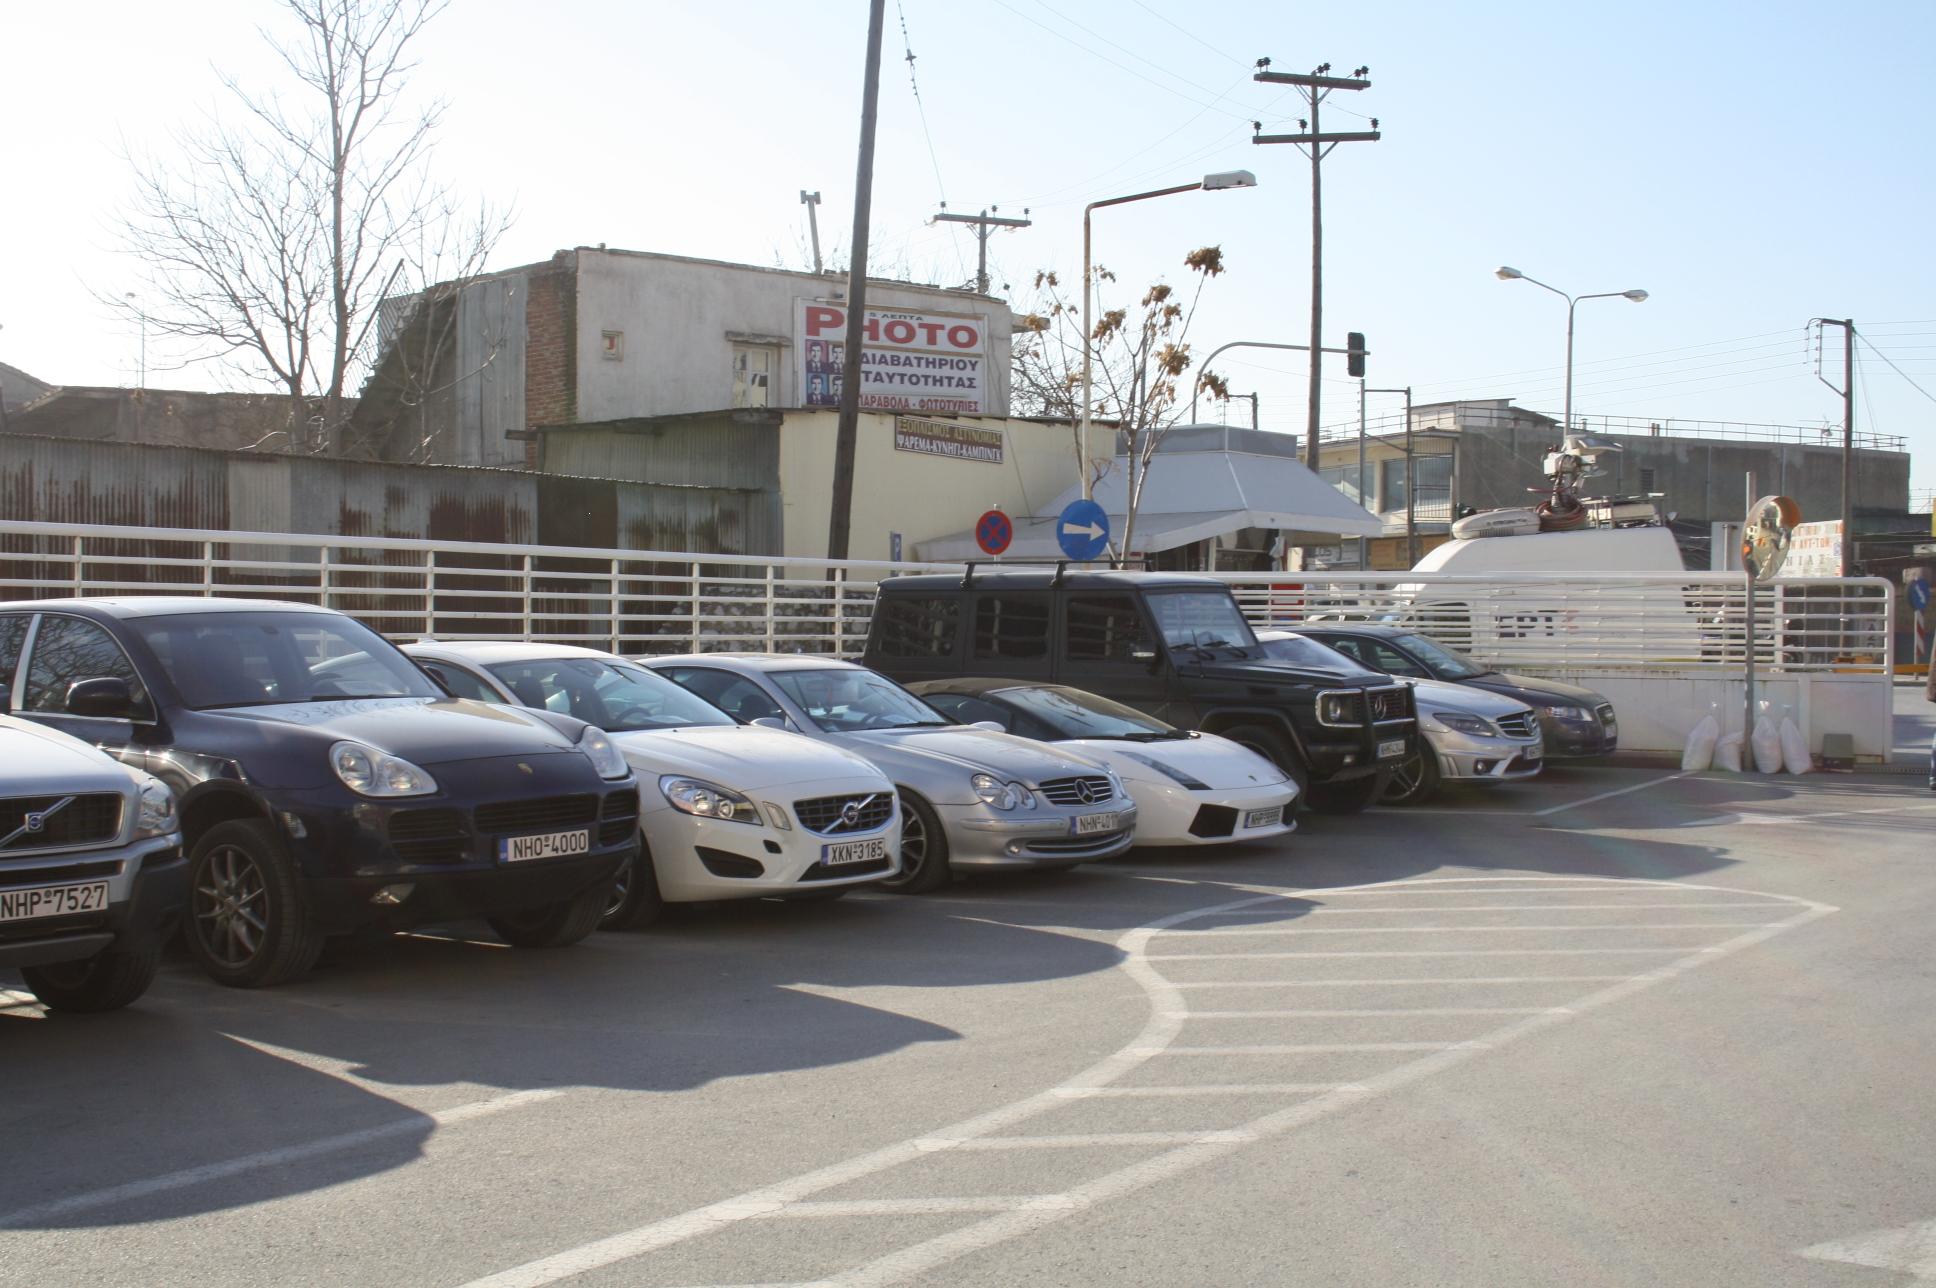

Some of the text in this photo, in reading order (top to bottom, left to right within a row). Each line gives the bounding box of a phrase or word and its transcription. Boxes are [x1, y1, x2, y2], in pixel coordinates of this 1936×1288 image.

[806, 306, 978, 349] PHOTO
[861, 351, 979, 372] ΔΙΑΒΑΤΗΡΙΟΥ
[861, 370, 977, 389] ΤΑΥΤΟΤΗΤΑΣ
